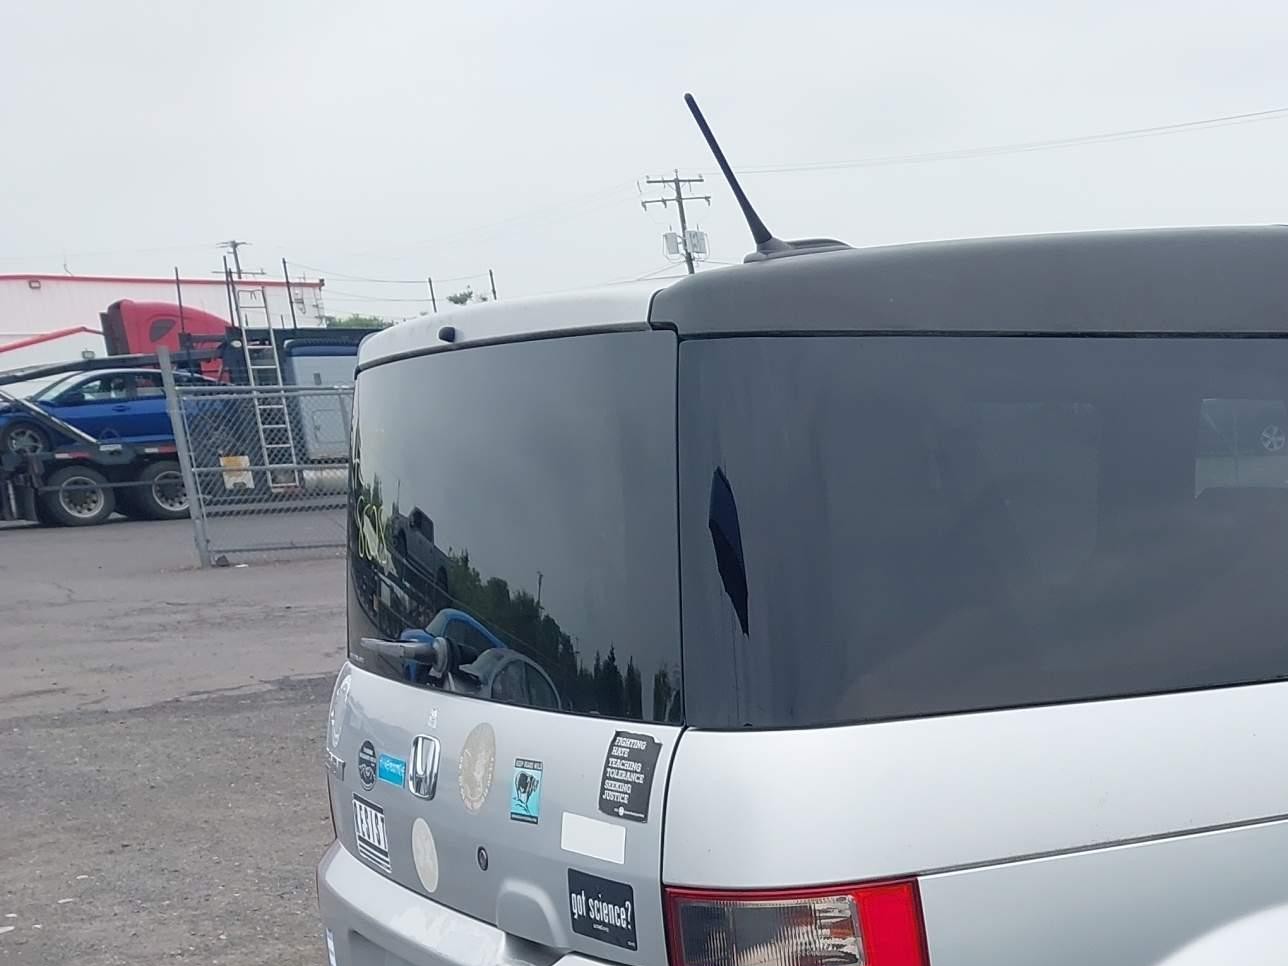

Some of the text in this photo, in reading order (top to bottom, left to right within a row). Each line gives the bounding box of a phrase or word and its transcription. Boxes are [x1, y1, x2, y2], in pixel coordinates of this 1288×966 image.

[615, 736, 648, 750] FIGHTING
[611, 746, 630, 757] HATE
[608, 757, 642, 772] TEACHING
[606, 768, 645, 784] TOLERANCE
[604, 780, 632, 793] SEEKING
[602, 790, 629, 804] JUSTICE
[571, 890, 632, 930] got science?
